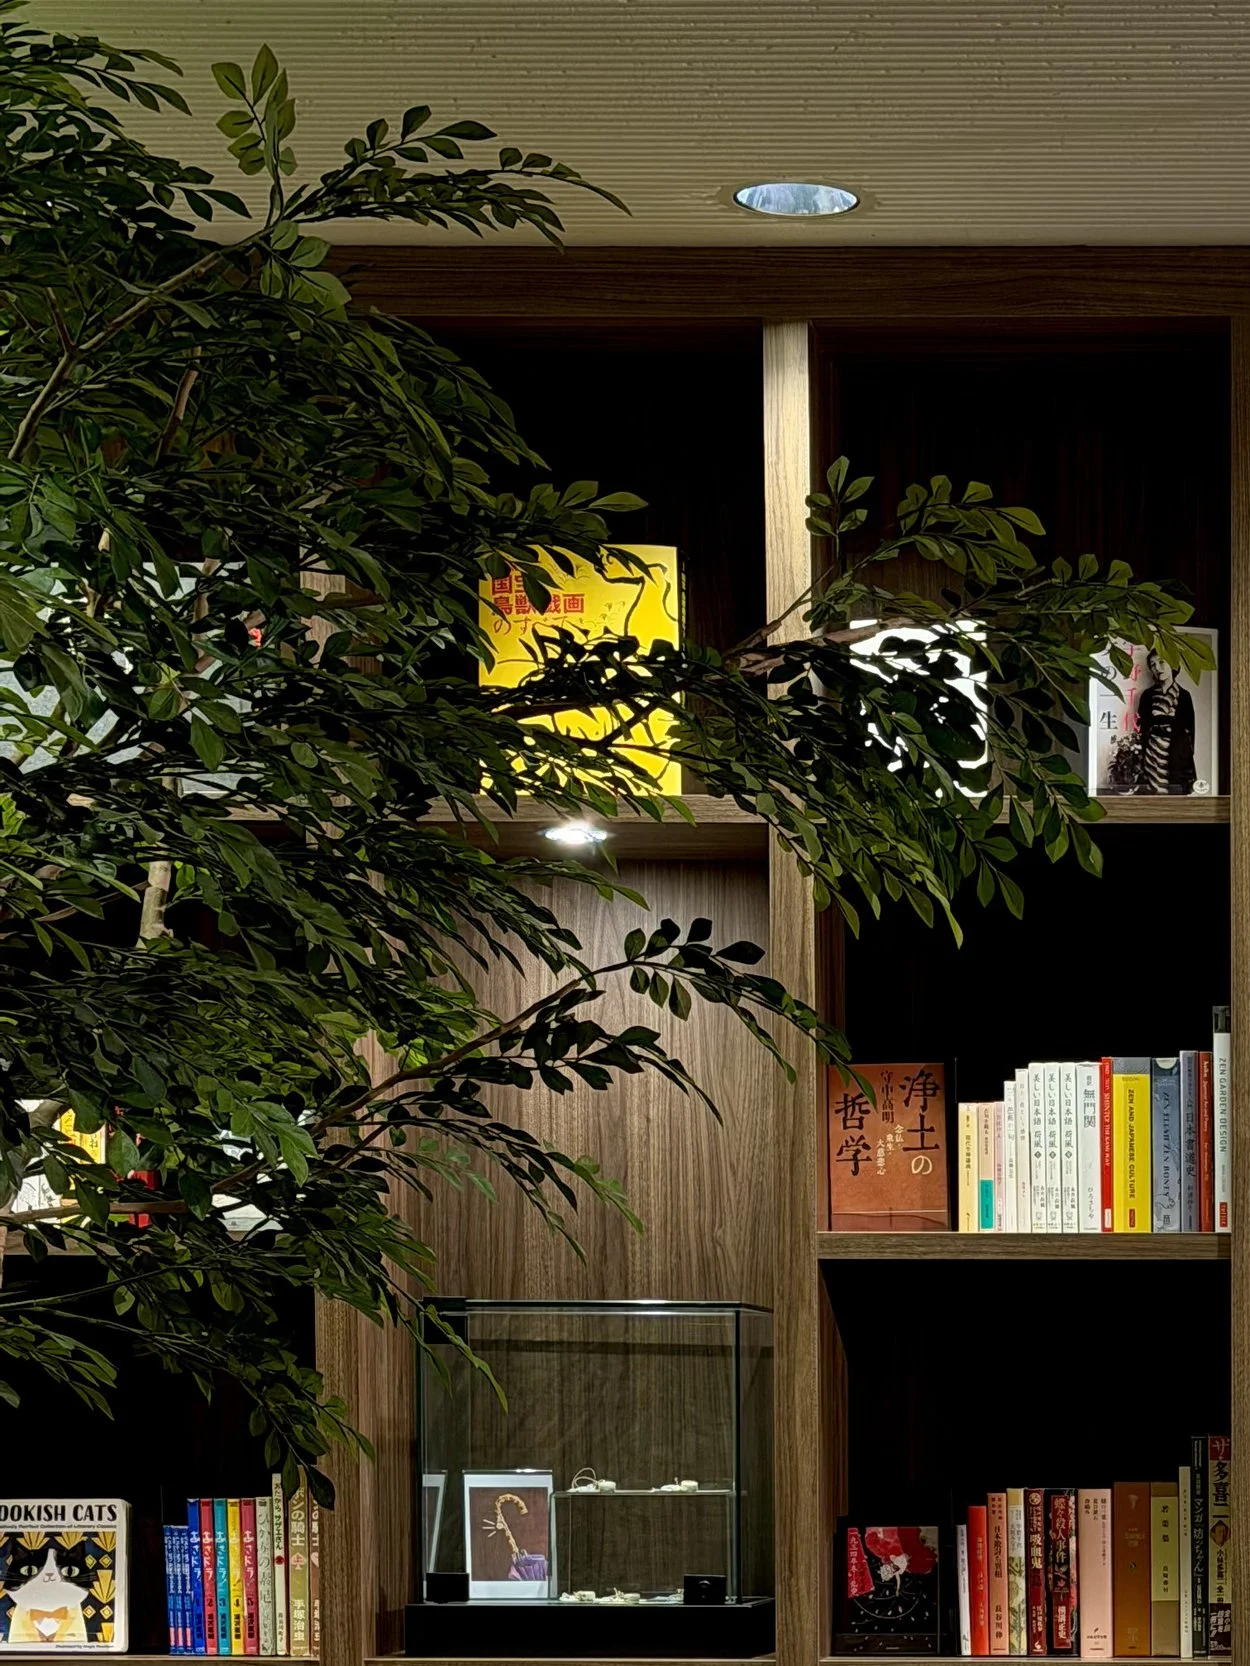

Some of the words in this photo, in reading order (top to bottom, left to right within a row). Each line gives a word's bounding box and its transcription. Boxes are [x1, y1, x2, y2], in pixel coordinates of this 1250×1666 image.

[1219, 1058, 1227, 1075] ZEN
[1219, 1077, 1227, 1115] GARDEN
[835, 1093, 872, 1176] 哲学
[899, 1069, 940, 1175] 浄土の
[1219, 1118, 1227, 1153] DESIGN
[72, 1504, 117, 1522] CATS
[1029, 1533, 1043, 1569] 吸血鬼
[292, 1599, 306, 1642] 手塚治虫
